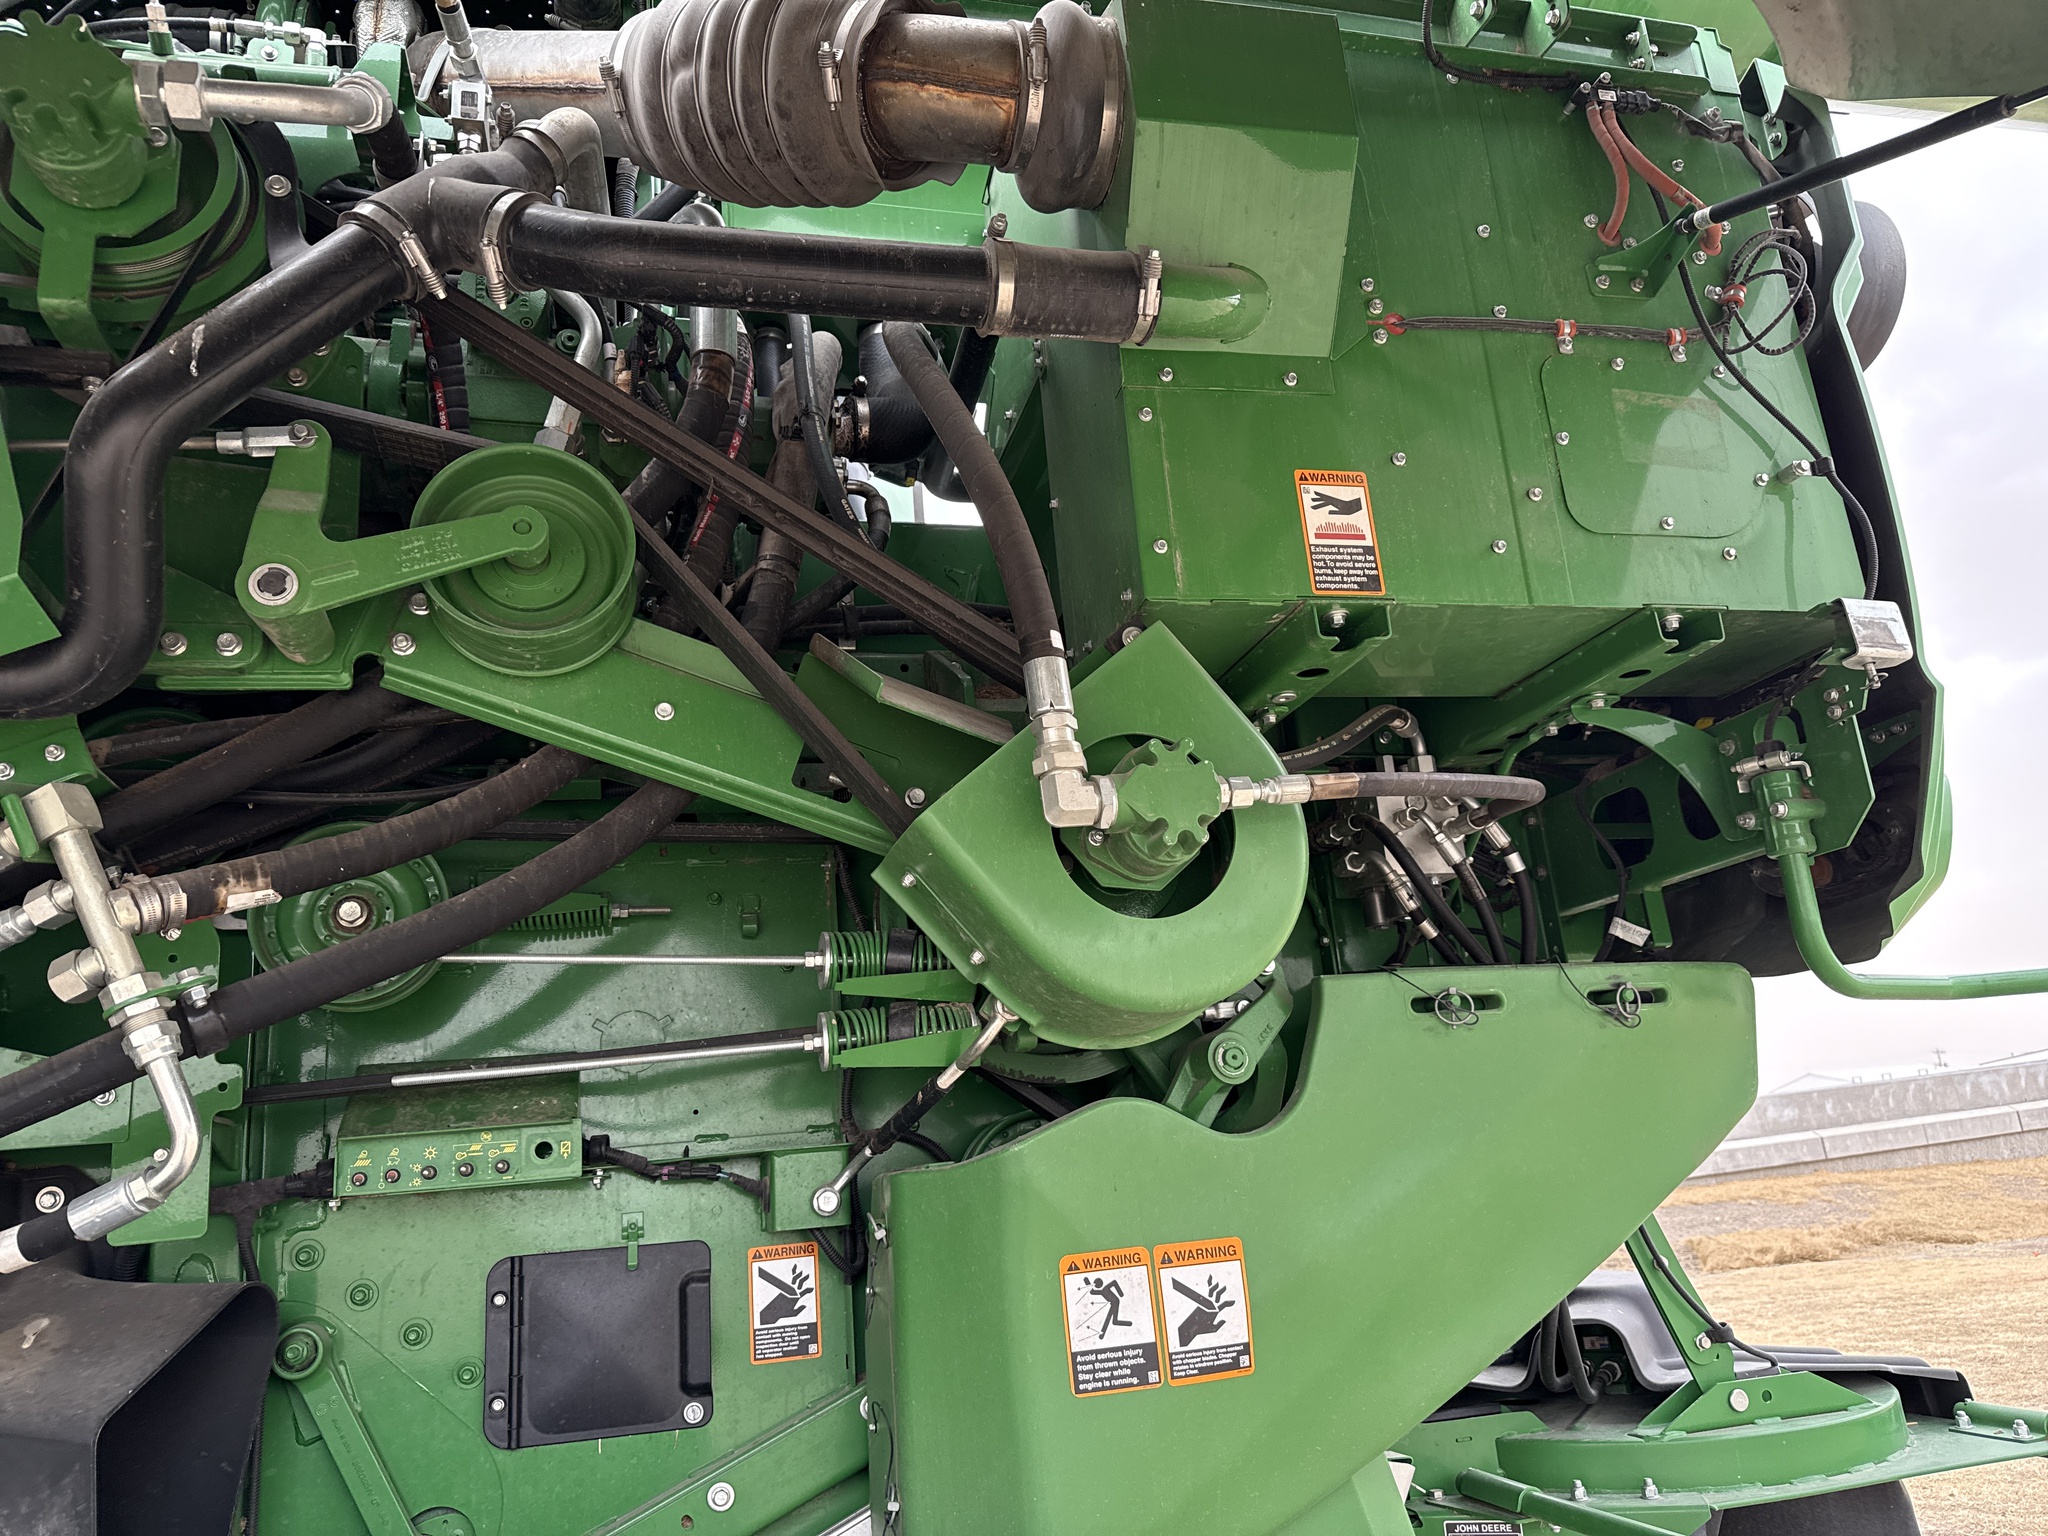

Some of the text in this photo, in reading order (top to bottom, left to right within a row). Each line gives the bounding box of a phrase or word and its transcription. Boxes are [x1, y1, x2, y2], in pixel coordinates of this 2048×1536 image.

[1309, 473, 1364, 483] WARNING
[841, 498, 855, 520] GATES
[764, 1244, 814, 1258] WARNING
[1174, 1245, 1236, 1261] WARNING
[1082, 1252, 1141, 1269] WARNING
[1077, 1354, 1096, 1362] Avoid
[1097, 1351, 1122, 1360] serious
[1077, 1357, 1146, 1371] from thrown objects.
[1078, 1373, 1093, 1381] Stay
[1113, 1368, 1131, 1376] while
[1079, 1382, 1102, 1390] engine
[1112, 1376, 1139, 1385] running.
[1454, 1524, 1512, 1532] JOHN DEERE
